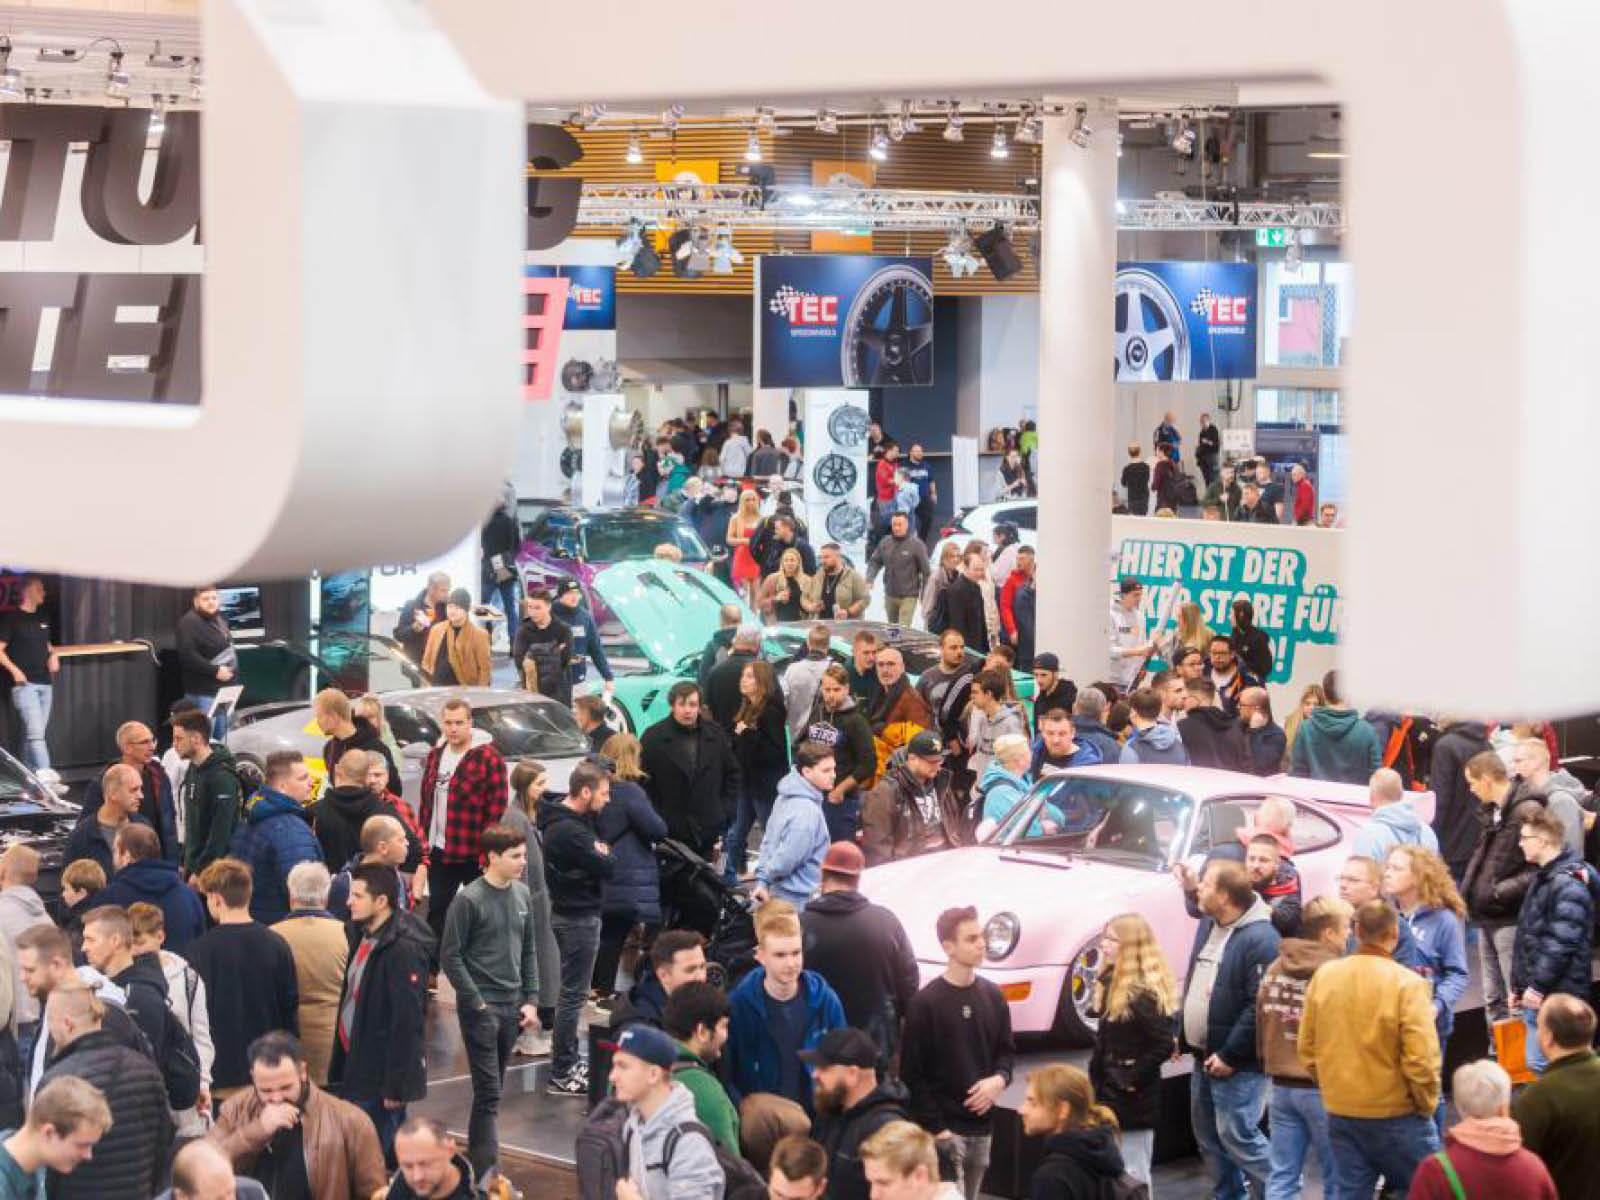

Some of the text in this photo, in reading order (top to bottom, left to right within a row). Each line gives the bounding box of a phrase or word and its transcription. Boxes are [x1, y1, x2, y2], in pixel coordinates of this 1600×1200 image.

[784, 295, 838, 322] TEC
[1204, 297, 1246, 321] TEC
[1121, 541, 1298, 586] HIER IST DER
